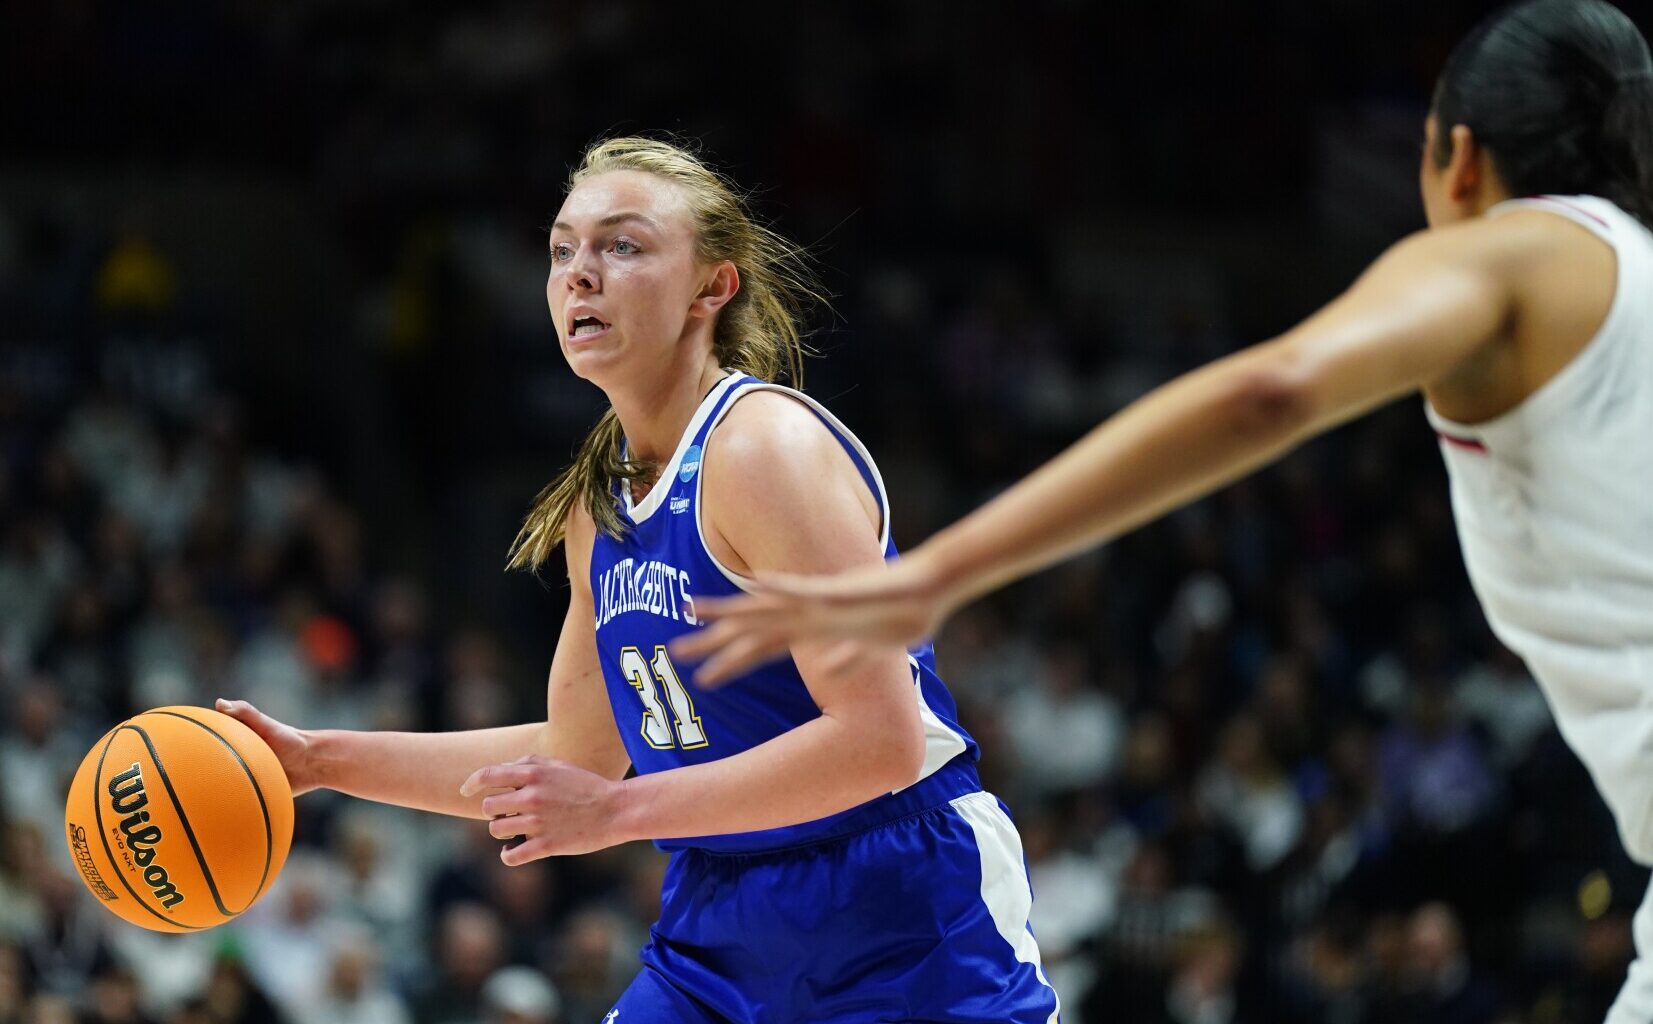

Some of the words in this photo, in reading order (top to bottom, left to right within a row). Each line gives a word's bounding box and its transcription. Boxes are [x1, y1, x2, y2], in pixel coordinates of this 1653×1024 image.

[620, 645, 708, 750] 31
[79, 840, 102, 882] MARCH
[108, 762, 184, 909] Wilson
[111, 828, 125, 850] EVO
[122, 852, 137, 873] NXT
